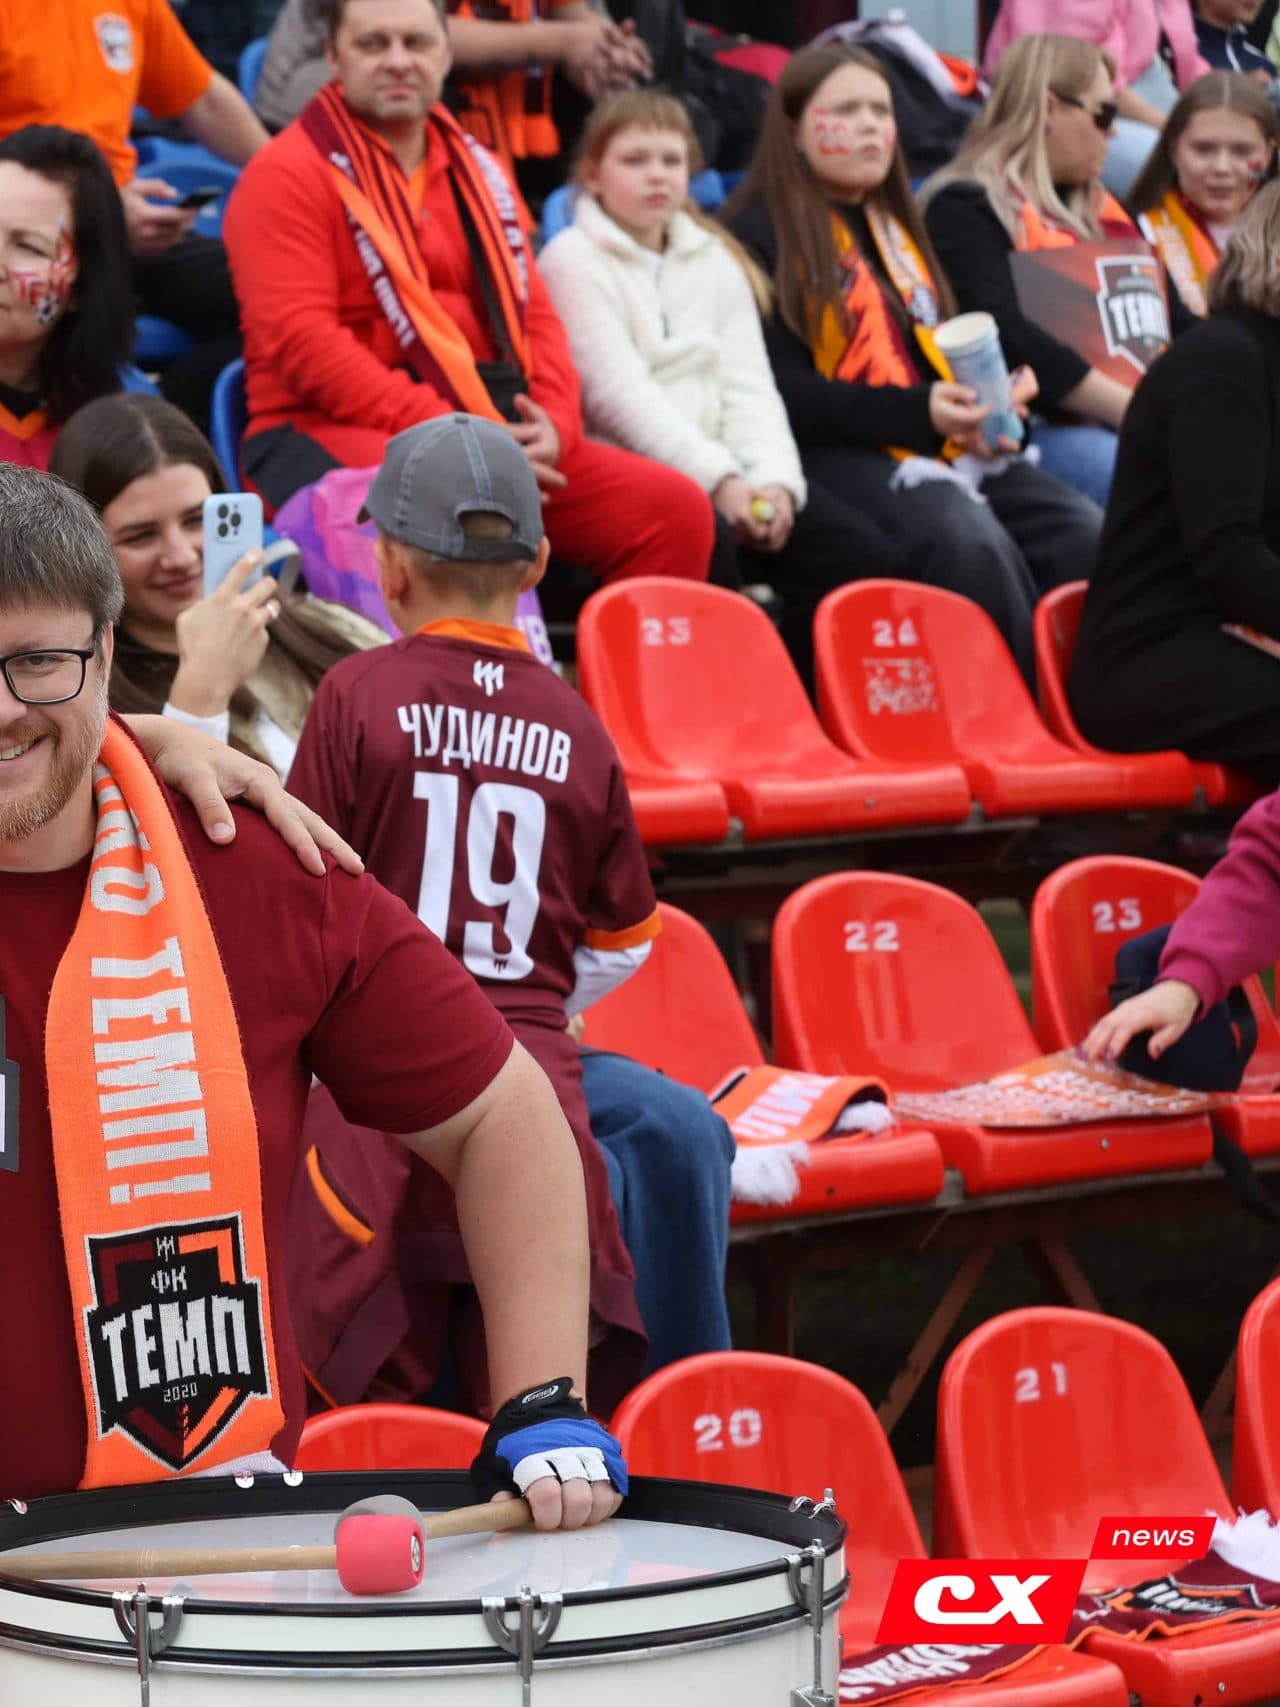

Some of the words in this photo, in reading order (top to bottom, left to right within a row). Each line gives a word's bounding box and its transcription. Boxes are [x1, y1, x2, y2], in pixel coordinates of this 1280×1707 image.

[397, 703, 571, 783] ЧУДИНОВ
[412, 771, 546, 980] 19
[843, 920, 901, 953] 22
[1092, 897, 1143, 933] 23
[90, 936, 212, 1206] ТЕМП!
[151, 1265, 188, 1294] ФК
[101, 1295, 252, 1402] ТЕМП
[163, 1382, 198, 1403] 2020
[1014, 1361, 1069, 1403] 21
[692, 1407, 764, 1453] 20
